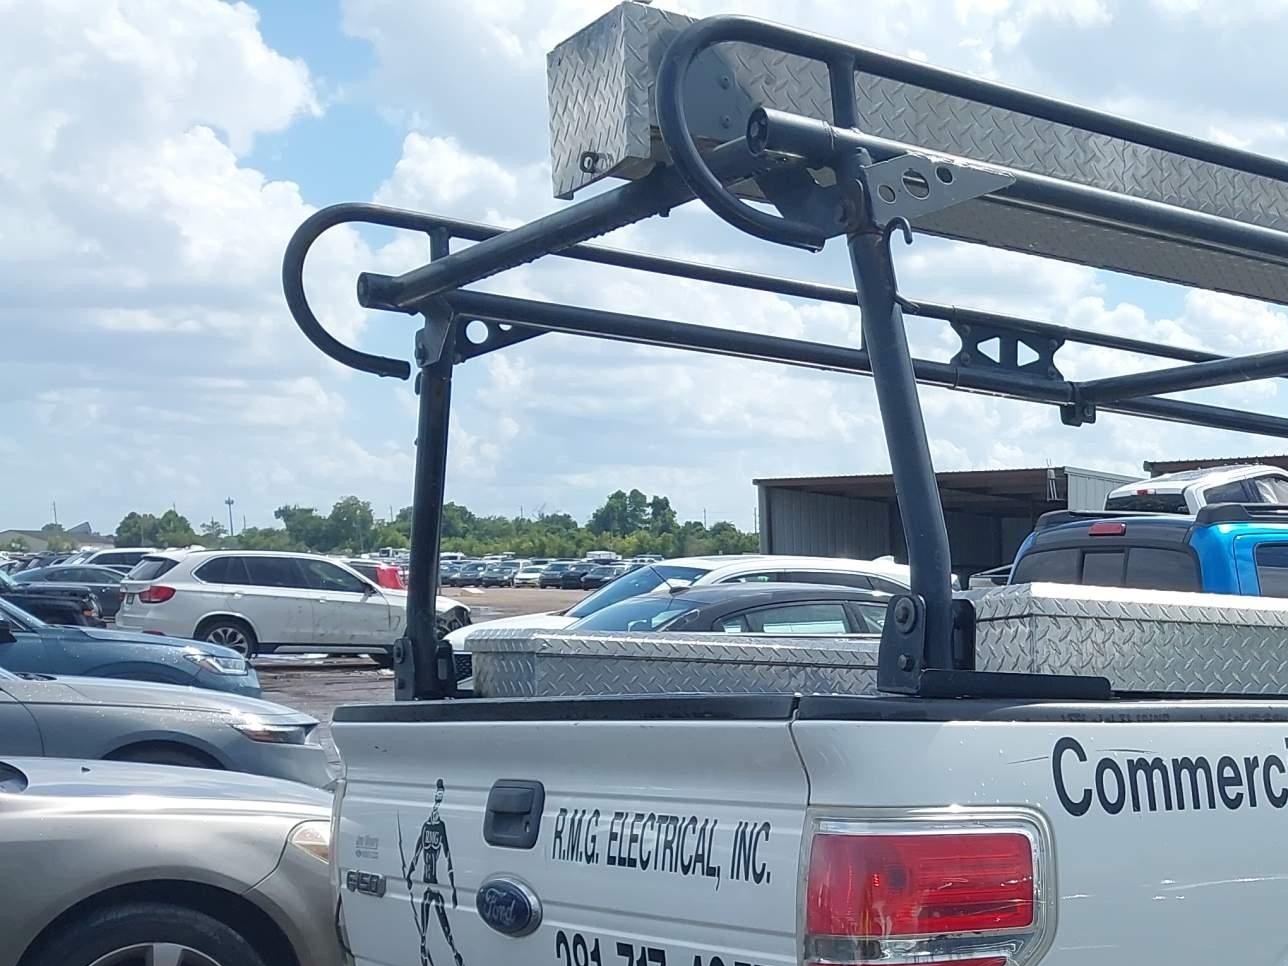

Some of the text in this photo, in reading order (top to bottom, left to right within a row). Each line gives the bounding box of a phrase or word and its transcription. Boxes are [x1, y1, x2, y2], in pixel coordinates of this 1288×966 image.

[552, 808, 771, 892] R.M.G. ELECTRICAL, INC.
[484, 887, 517, 924] Ford
